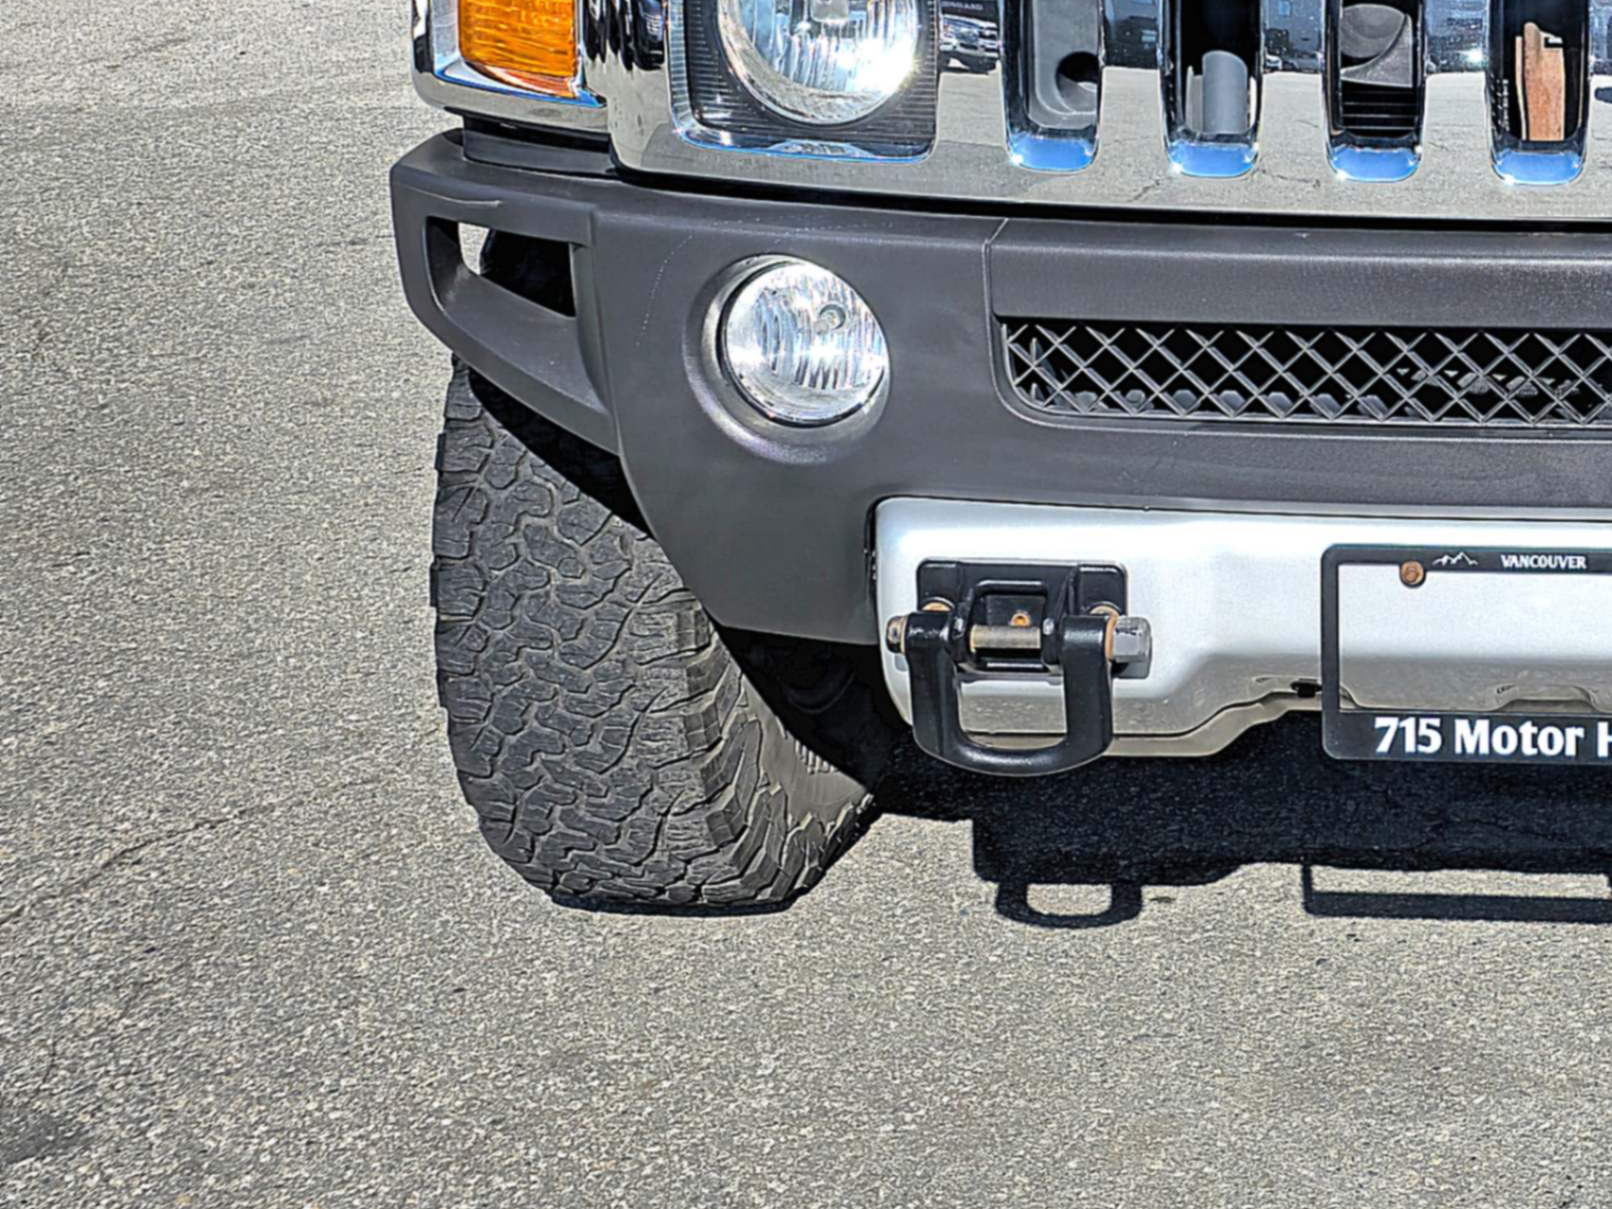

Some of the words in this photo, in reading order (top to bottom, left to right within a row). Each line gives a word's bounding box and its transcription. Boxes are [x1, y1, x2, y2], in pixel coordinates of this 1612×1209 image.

[1500, 554, 1587, 569] VANCOUVER
[1374, 716, 1443, 754] 715
[1454, 718, 1585, 757] Motor
